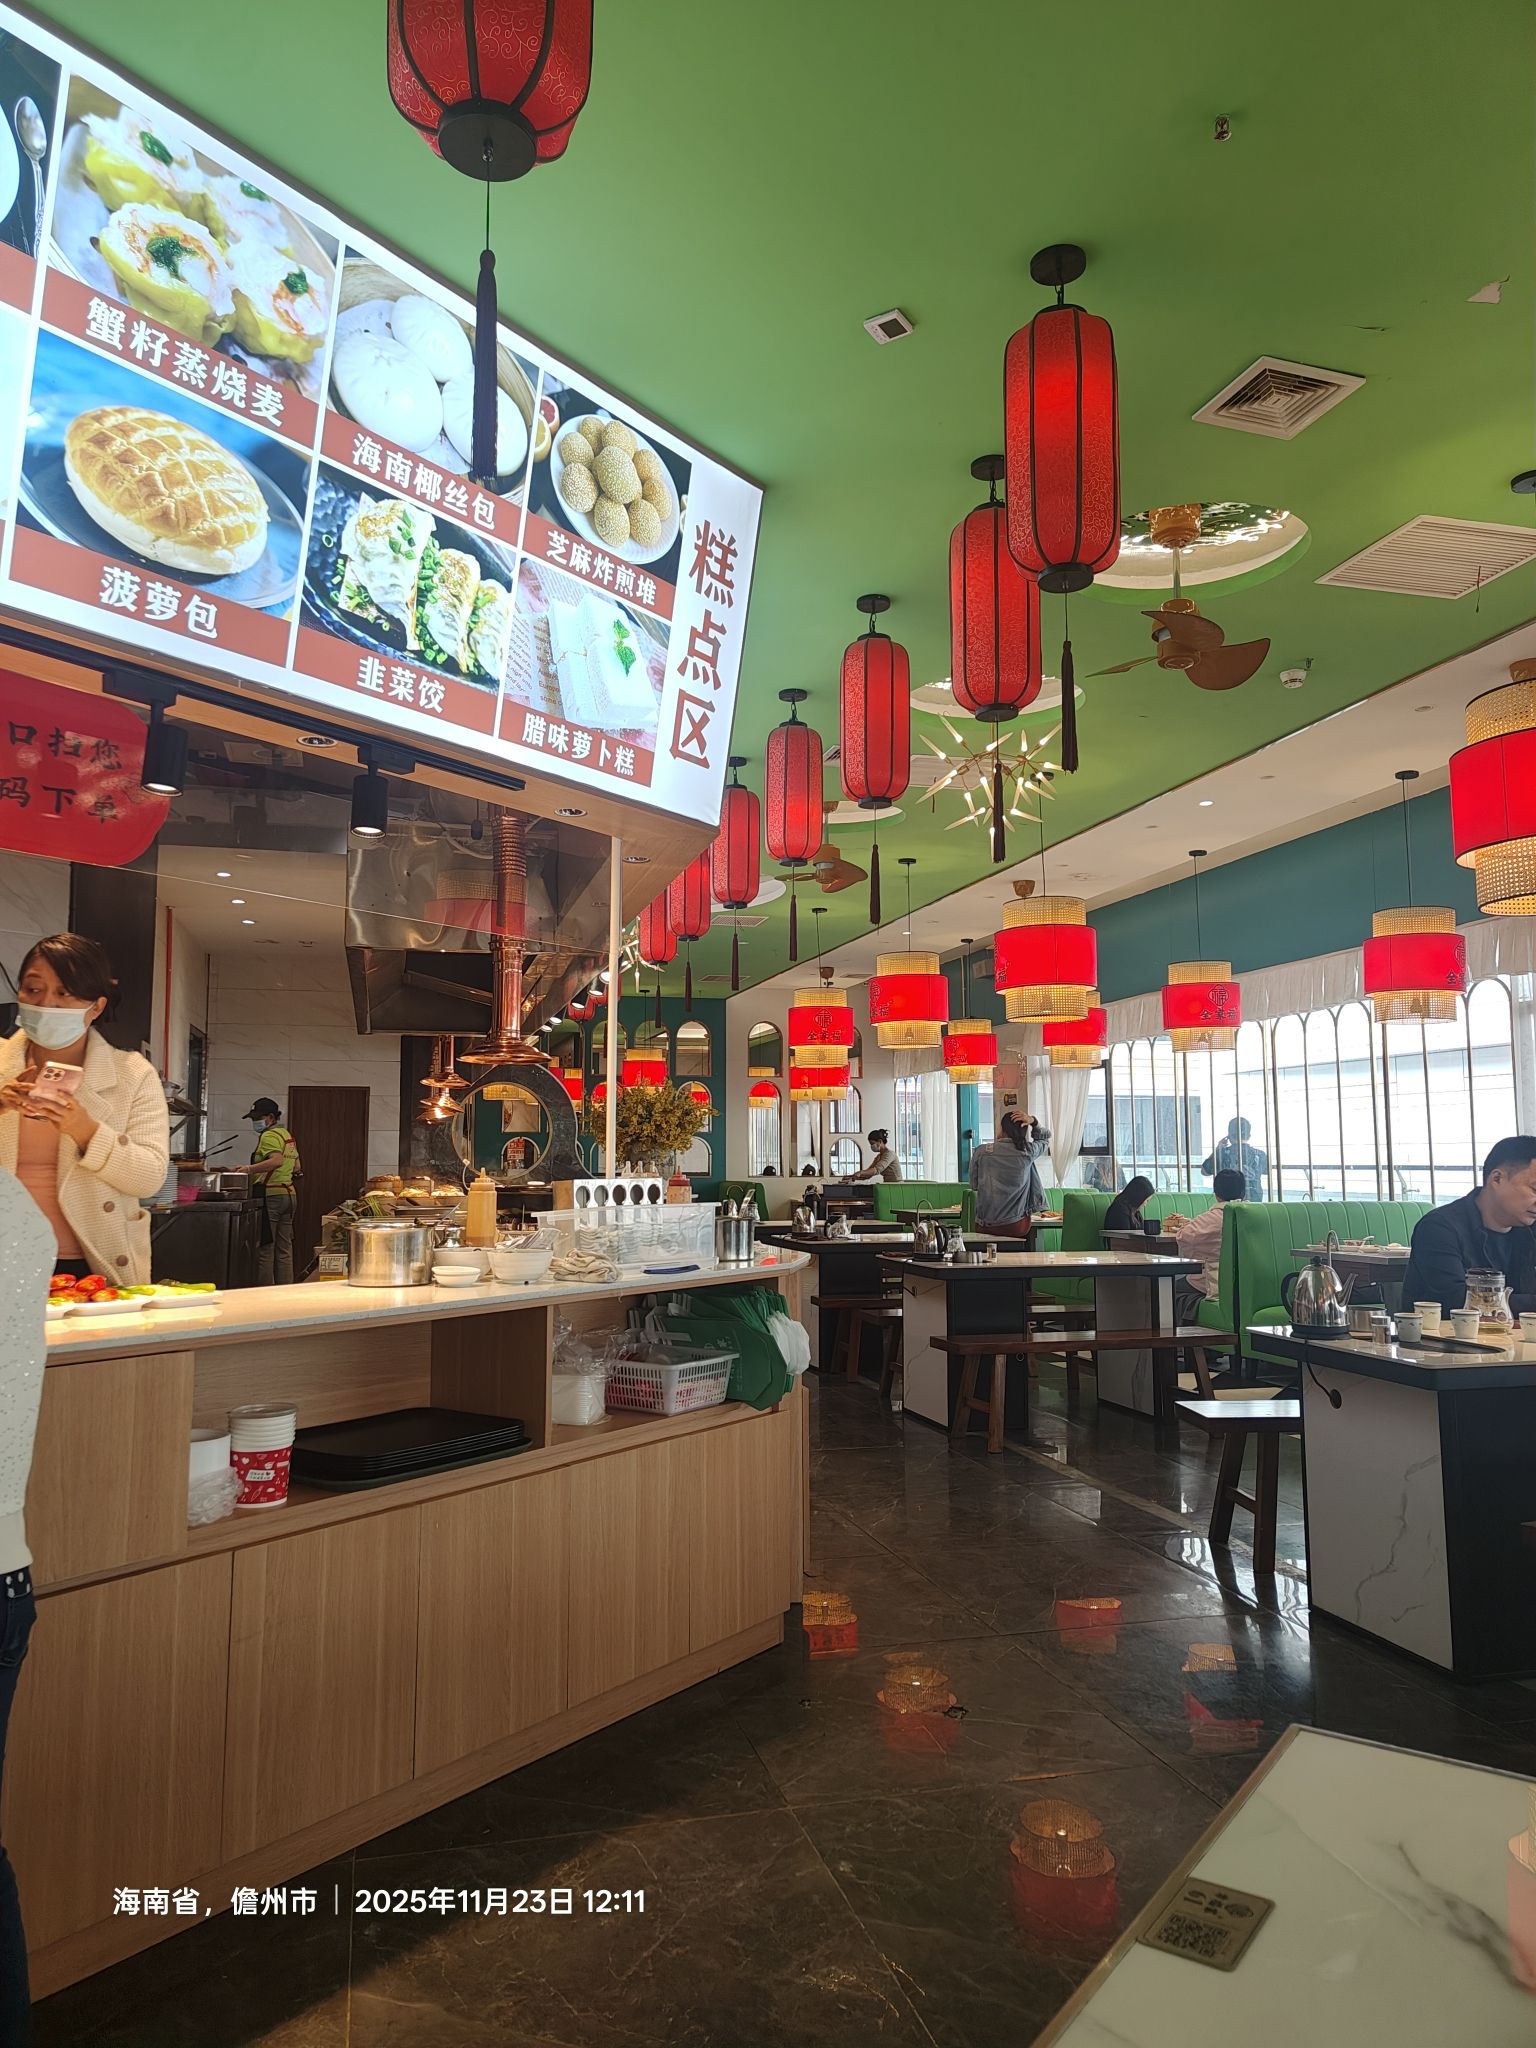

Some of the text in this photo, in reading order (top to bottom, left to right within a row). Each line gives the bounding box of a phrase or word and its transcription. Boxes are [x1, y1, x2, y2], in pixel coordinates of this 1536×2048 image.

[85, 297, 284, 427] 蟹籽蒸烧麦
[352, 432, 497, 531] 海南椰丝包
[98, 566, 218, 639] 菠萝包
[546, 529, 657, 607] 芝麻炸煎堆
[669, 519, 738, 769] 糕点区
[356, 655, 446, 714] 韭菜饺
[521, 713, 636, 777] 腊味萝卜糕
